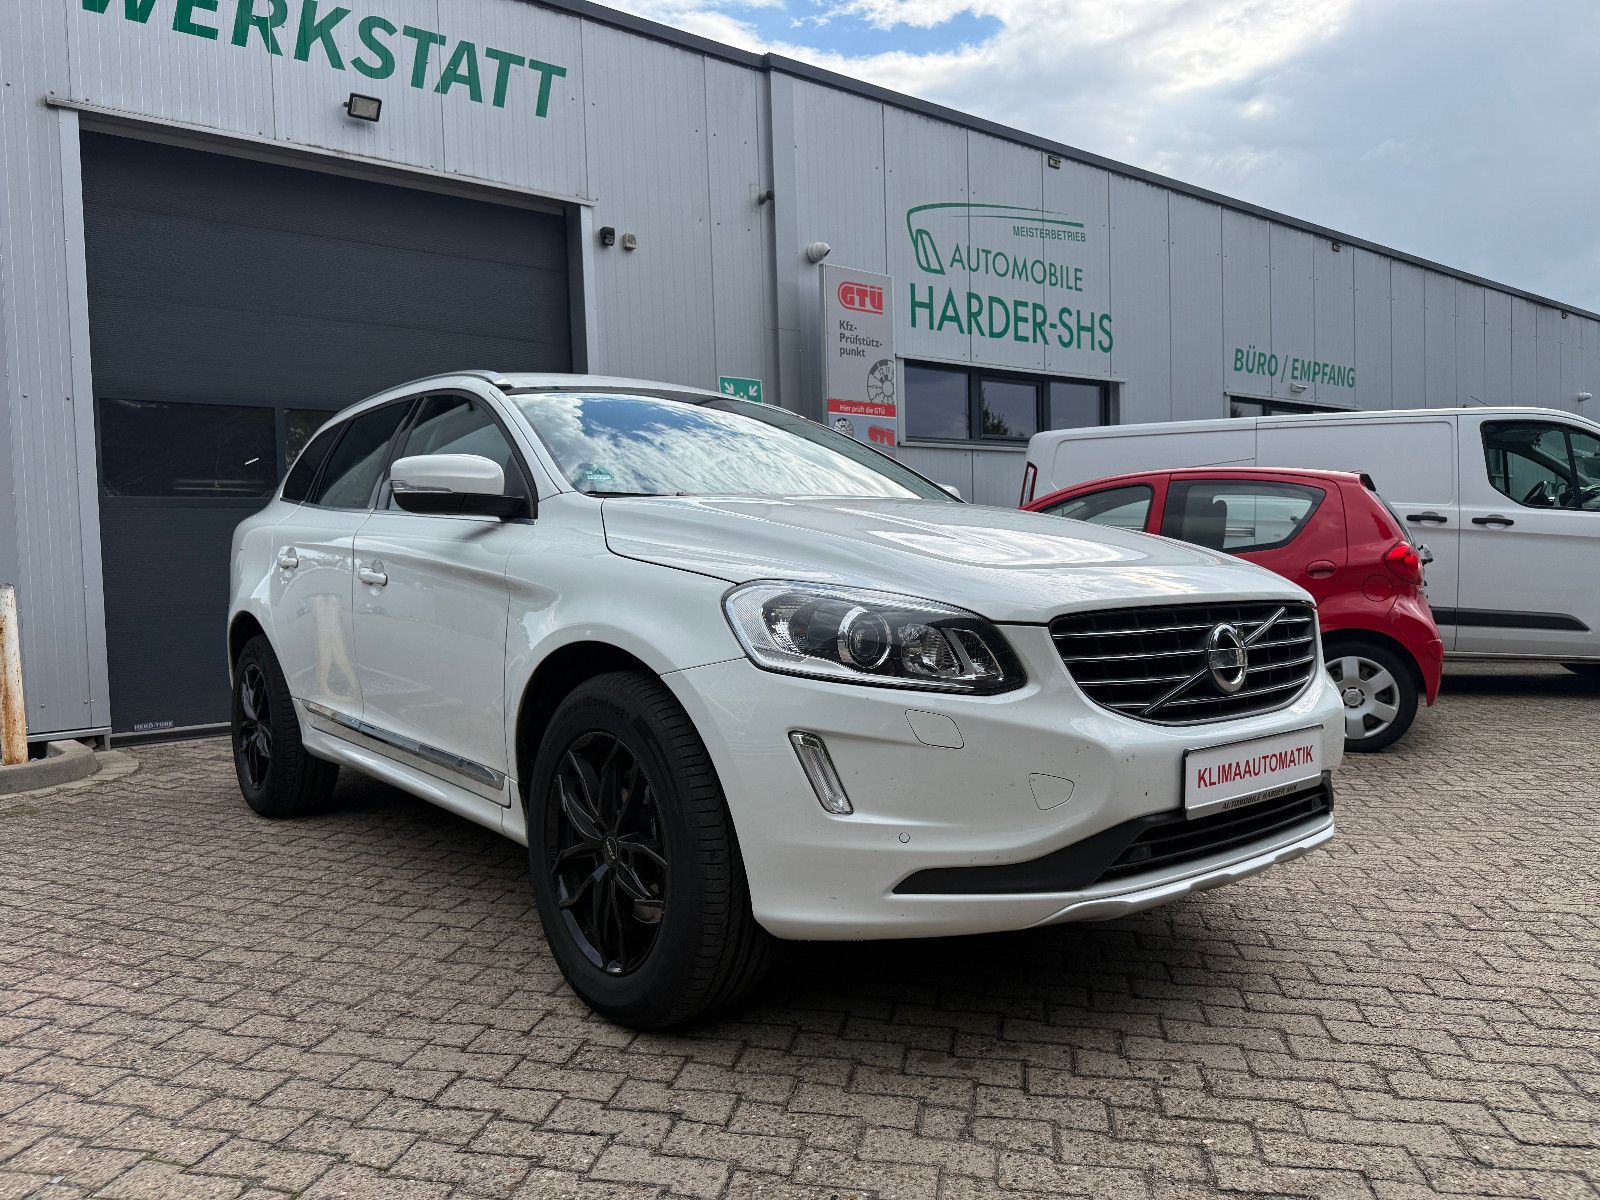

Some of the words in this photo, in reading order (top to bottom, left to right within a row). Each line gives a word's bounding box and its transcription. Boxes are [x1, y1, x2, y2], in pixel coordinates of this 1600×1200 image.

[1012, 225, 1086, 243] MEISTERBETRIEB
[949, 242, 1084, 293] AUTOMOBILE
[839, 319, 858, 332] Kfz-
[909, 282, 1115, 354] HARDER-SHS
[839, 332, 883, 348] Prüfstütz-
[839, 346, 866, 358] punkt
[1233, 344, 1279, 377] BÜRO
[1280, 354, 1289, 384] /
[1291, 357, 1356, 389] EMPFANG
[839, 404, 851, 412] Hier
[1197, 745, 1313, 788] KLIMAAUTOMATIK
